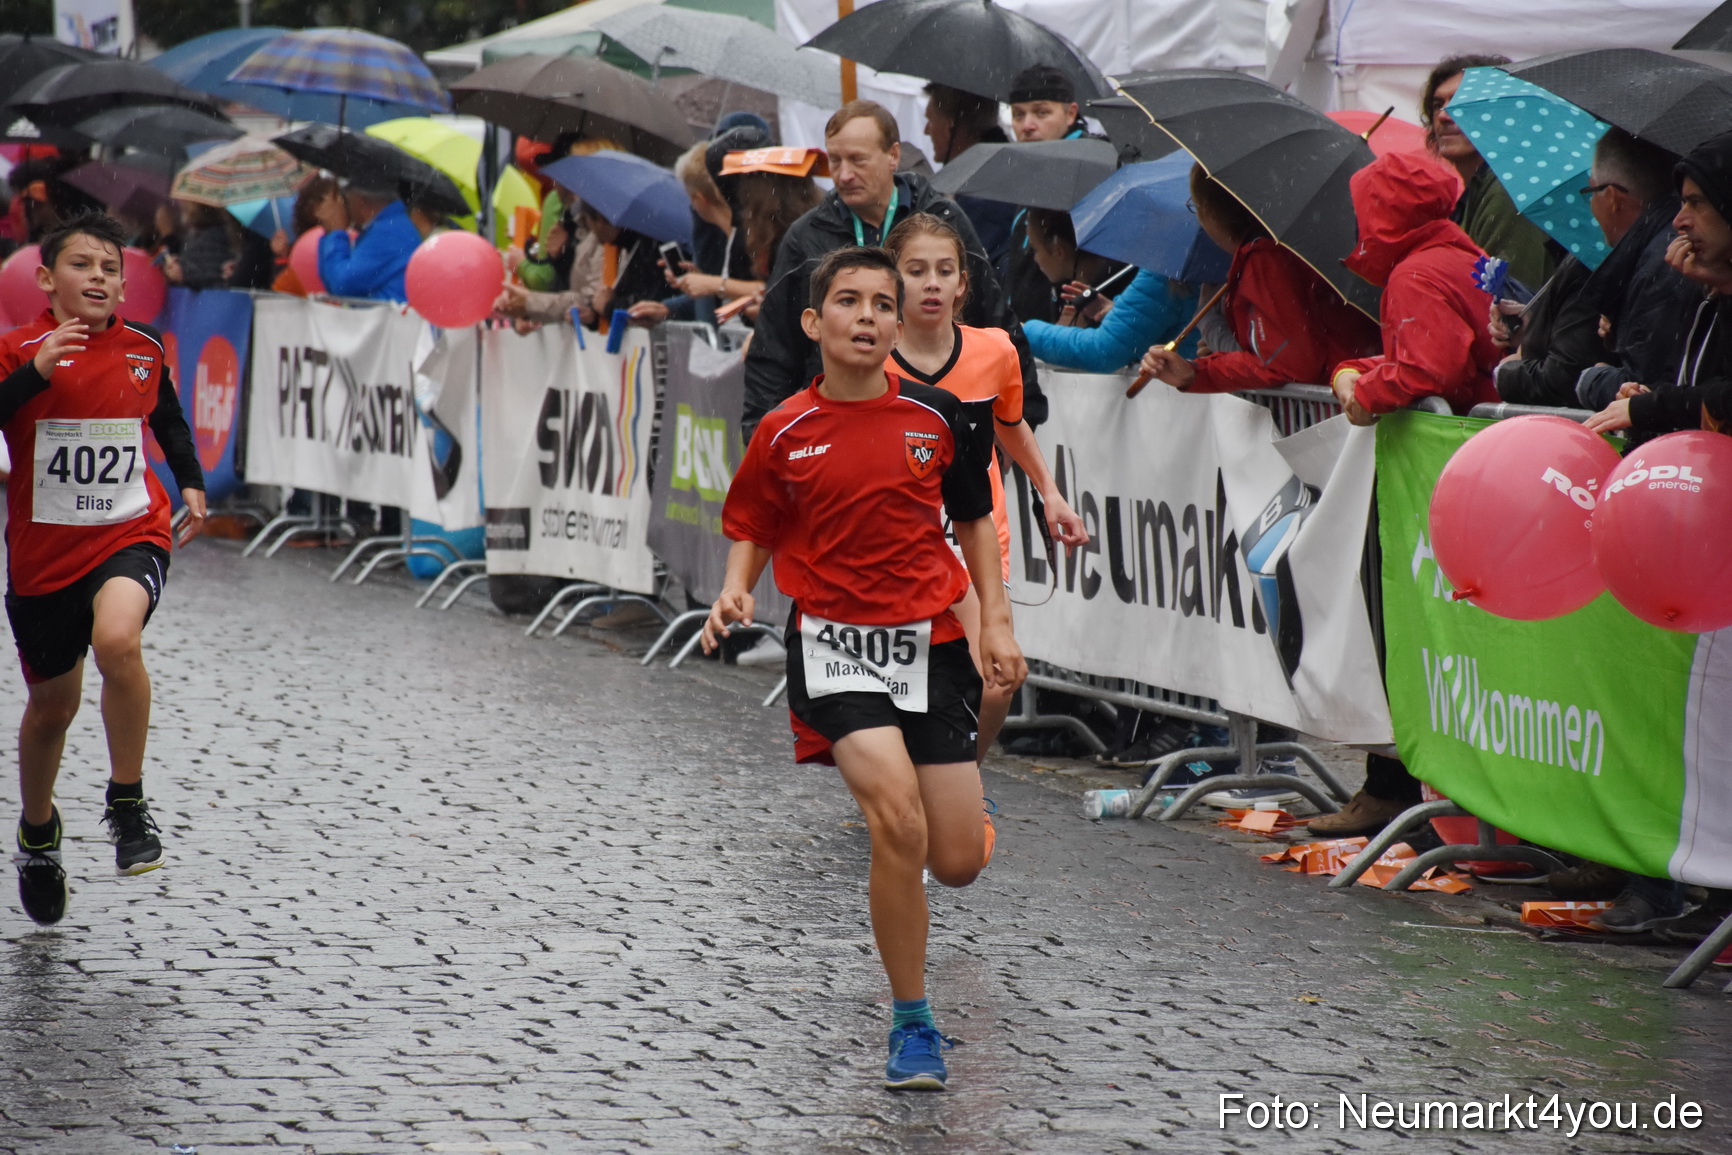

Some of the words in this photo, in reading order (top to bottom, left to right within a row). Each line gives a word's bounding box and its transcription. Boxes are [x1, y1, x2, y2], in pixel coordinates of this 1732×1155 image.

[134, 366, 150, 381] ASV
[89, 423, 136, 435] BOCK
[905, 431, 939, 441] NEUMARKT
[788, 444, 832, 461] saller
[914, 445, 933, 464] ASV
[47, 445, 137, 485] 4027
[1541, 467, 1599, 511] RÖ
[1605, 459, 1704, 502] RÖDL
[1648, 480, 1701, 493] energie
[76, 494, 113, 511] Elias
[817, 624, 918, 668] 4005
